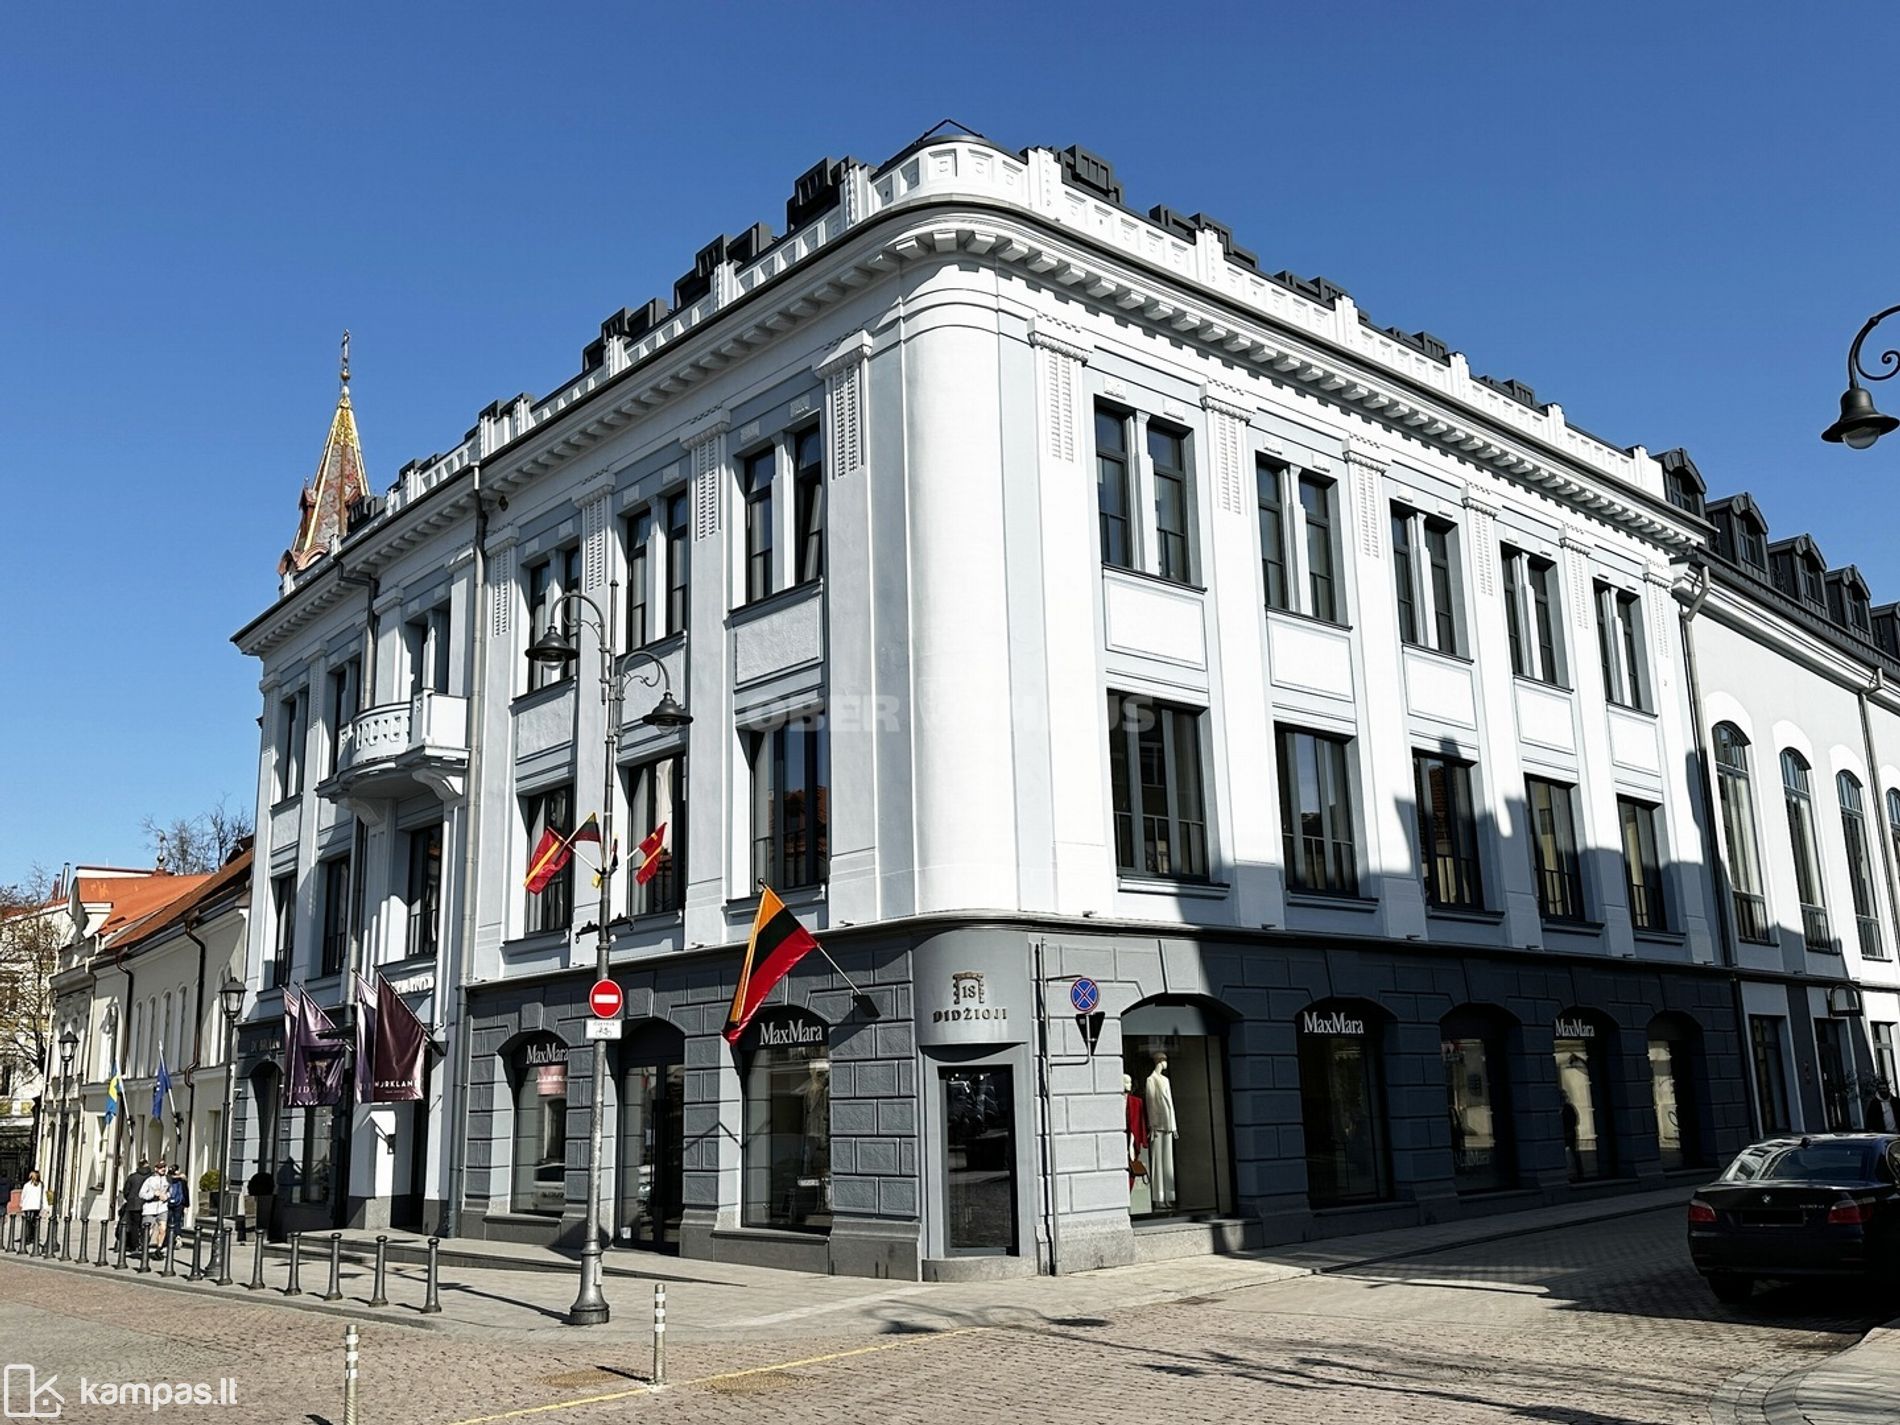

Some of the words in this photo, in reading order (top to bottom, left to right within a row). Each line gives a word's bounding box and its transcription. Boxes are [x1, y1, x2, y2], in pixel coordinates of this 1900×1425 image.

[962, 985, 976, 999] 18
[932, 1007, 1007, 1023] DIDŽIOJI
[1303, 1011, 1364, 1034] MaxMara
[759, 1019, 823, 1046] MaxMara
[1555, 1018, 1595, 1037] MaxMara
[525, 1042, 569, 1065] MaxMara
